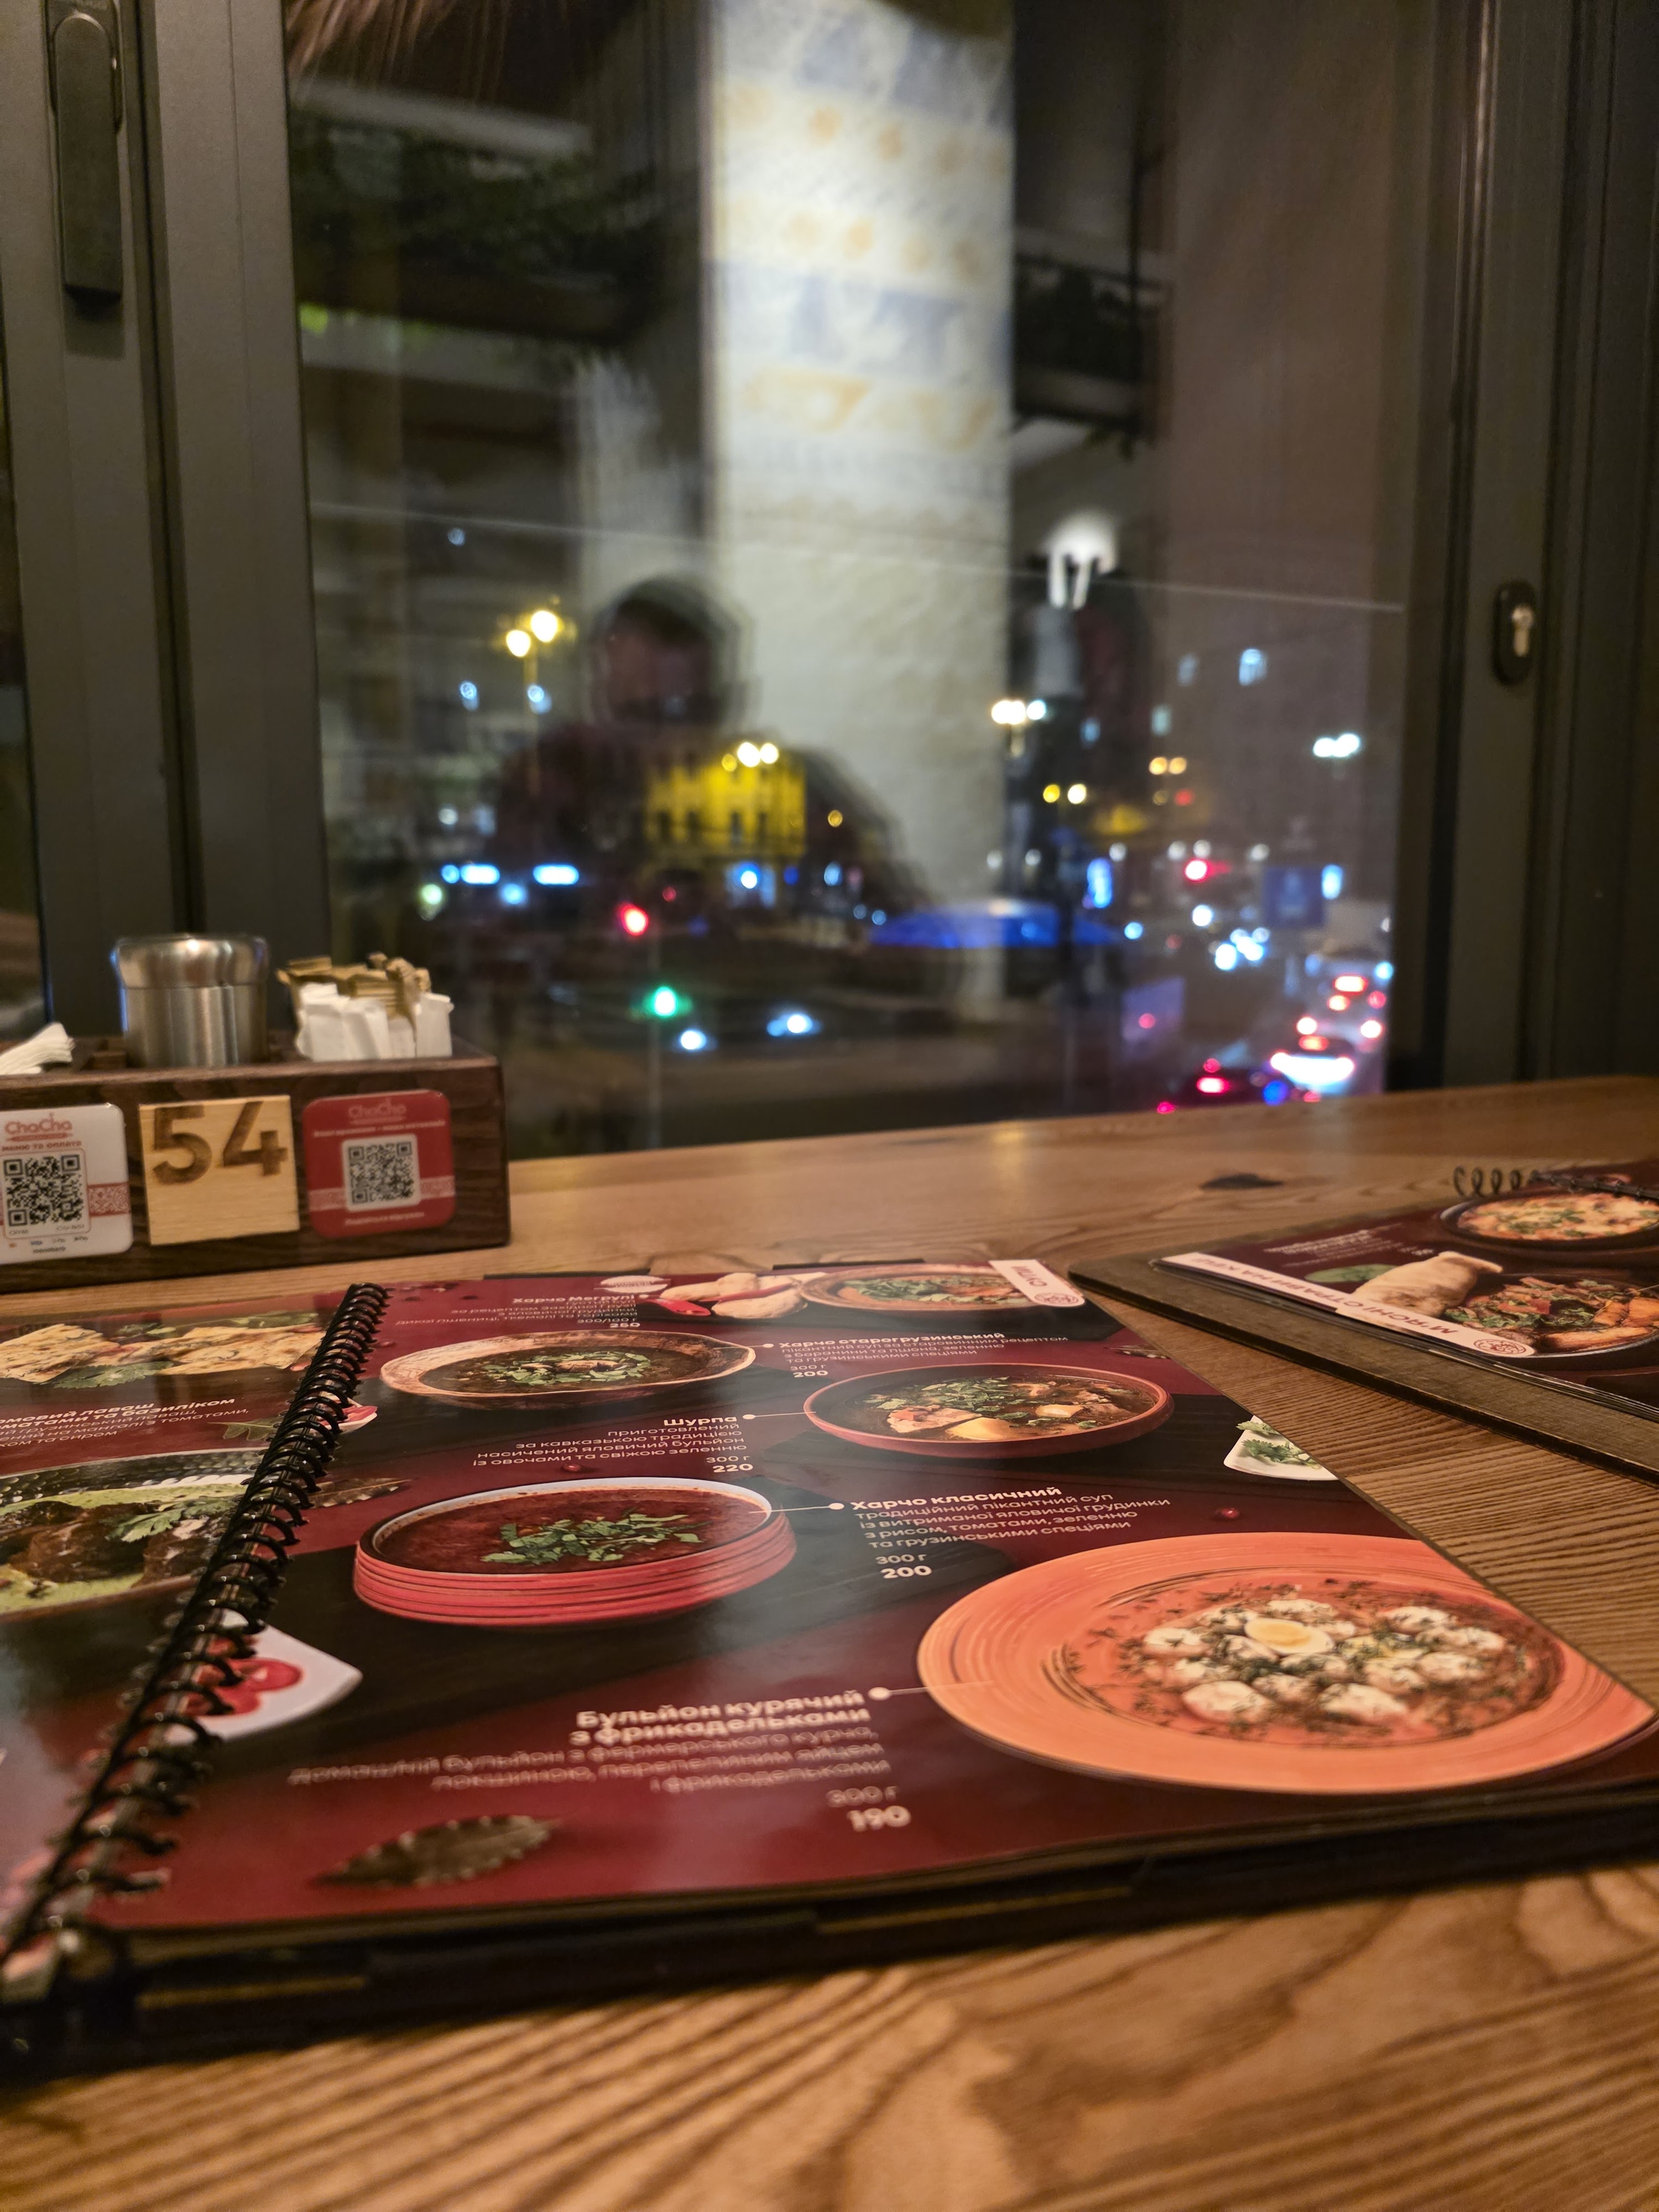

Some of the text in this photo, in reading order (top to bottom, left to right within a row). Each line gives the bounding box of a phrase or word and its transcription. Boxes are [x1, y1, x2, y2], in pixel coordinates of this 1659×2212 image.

[152, 1100, 289, 1185] 54
[782, 1344, 854, 1353] пікантний
[903, 1339, 997, 1347] старовинним
[838, 1333, 1005, 1344] старогрузинський
[795, 1349, 868, 1358] баранини
[806, 1353, 909, 1362] грузинськими
[0, 1416, 88, 1430] матами
[122, 1399, 235, 1417] базиліком
[79, 1402, 155, 1416] лаваш
[19, 1416, 133, 1434] грузинський
[137, 1410, 197, 1421] лаваш,
[74, 1421, 145, 1433] мангалі
[161, 1408, 249, 1423] томатами,
[608, 1423, 740, 1437] приготовлений
[663, 1416, 738, 1426] Шурпа
[59, 1431, 117, 1441] сиром
[540, 1437, 648, 1448] кавказькою
[649, 1431, 742, 1441] традицією
[477, 1438, 744, 1458] насичений яловичий бульйон
[491, 1455, 572, 1465] овочами
[599, 1449, 666, 1458] свіжою
[669, 1444, 747, 1454] зеленню
[712, 1463, 754, 1473] 220
[849, 1486, 1062, 1510] Харчо класичний
[854, 1494, 1114, 1520] традиційний пікантний суп
[879, 1511, 994, 1527] витриманої
[995, 1505, 1081, 1519] яловичої
[1083, 1499, 1171, 1512] грудинки
[868, 1521, 1132, 1549] та грузинськими спеціями
[879, 1526, 947, 1539] рисом,
[947, 1518, 1051, 1532] томатами,
[1052, 1511, 1138, 1524] зеленню
[875, 1553, 927, 1565] 300 г
[880, 1565, 933, 1579] 200
[576, 1689, 865, 1729] Бульйон курячий
[567, 1707, 872, 1746] з фрикадельками
[846, 1805, 912, 1833] 190
